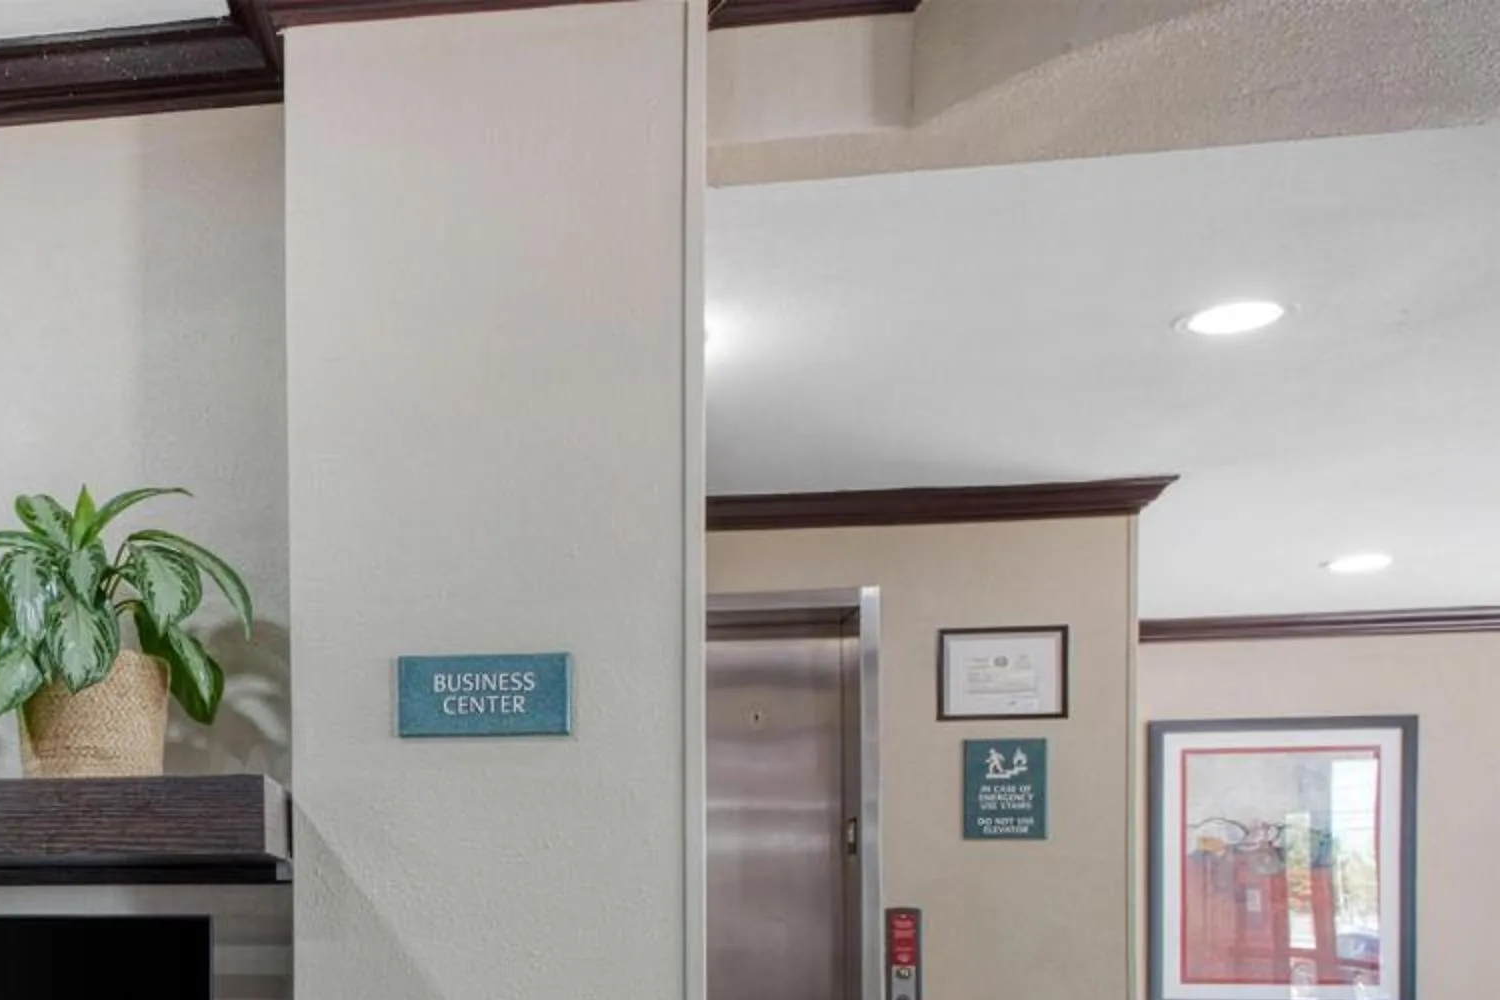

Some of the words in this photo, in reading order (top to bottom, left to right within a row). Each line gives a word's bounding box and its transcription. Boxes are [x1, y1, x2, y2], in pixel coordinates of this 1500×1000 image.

[433, 671, 536, 693] BUSINESS
[443, 695, 526, 715] CENTER
[993, 785, 1017, 793] CASE
[978, 793, 1034, 801] EMERGENCY
[977, 817, 993, 826] DO
[995, 817, 1014, 825] NOT
[982, 825, 1029, 834] ELEVATOR
